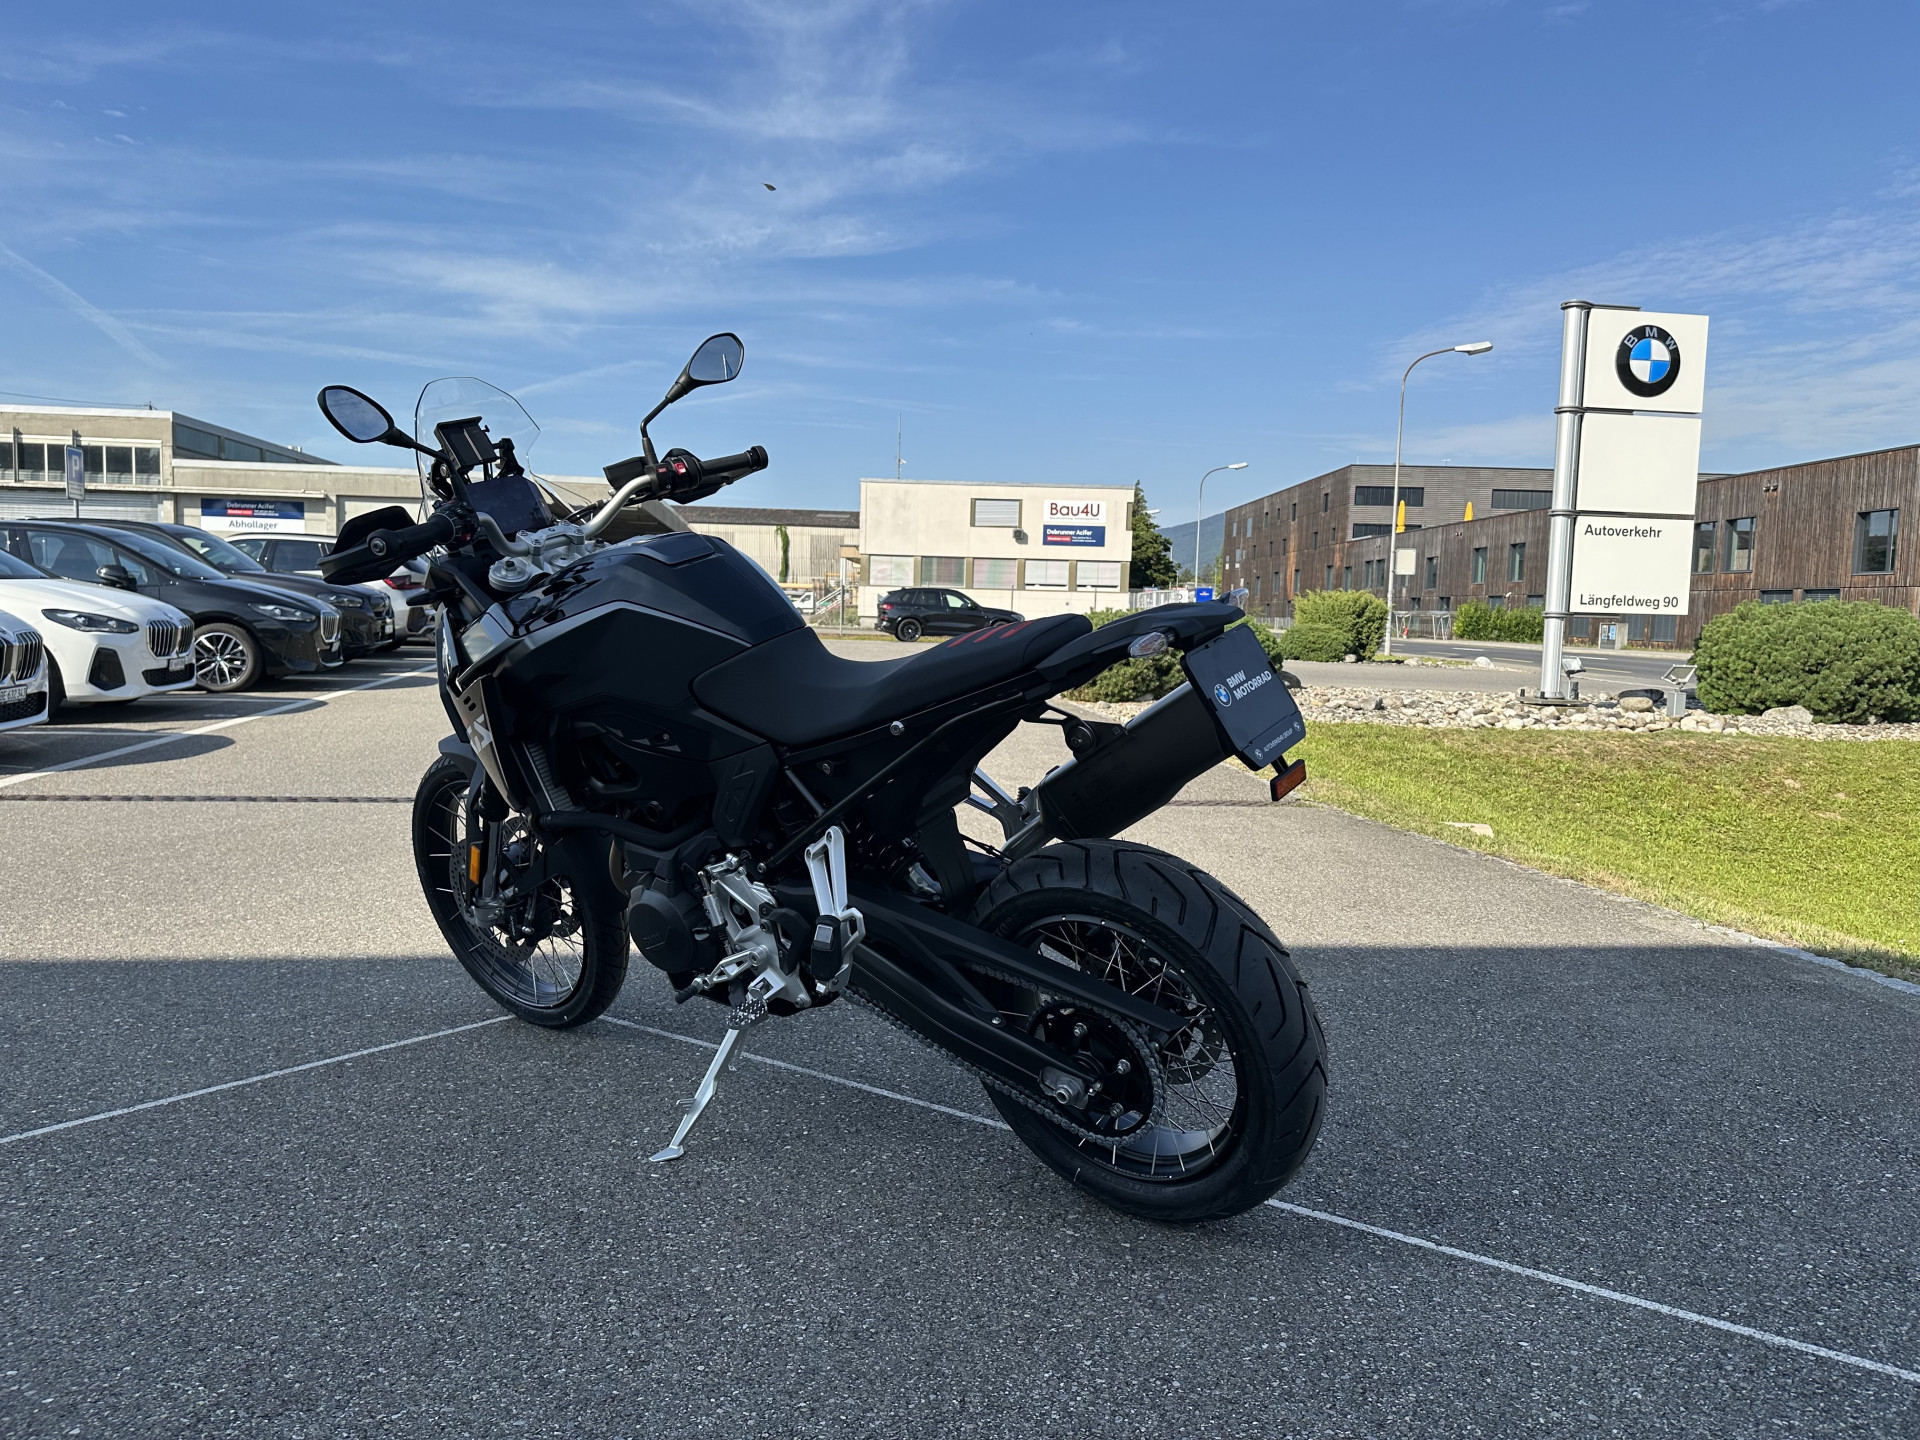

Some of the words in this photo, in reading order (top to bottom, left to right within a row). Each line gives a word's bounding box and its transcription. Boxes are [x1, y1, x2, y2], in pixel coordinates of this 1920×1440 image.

[1623, 326, 1677, 351] BMW
[72, 455, 79, 478] P
[226, 502, 257, 510] Debrunner
[1050, 502, 1100, 517] Bau4U
[229, 520, 278, 531] Abhollager
[1584, 524, 1662, 538] Autoverkehr
[1580, 594, 1660, 610] Längfeldweg
[1663, 596, 1679, 608] 90
[1226, 670, 1247, 689] BMW
[1233, 671, 1272, 700] MOTORRAD
